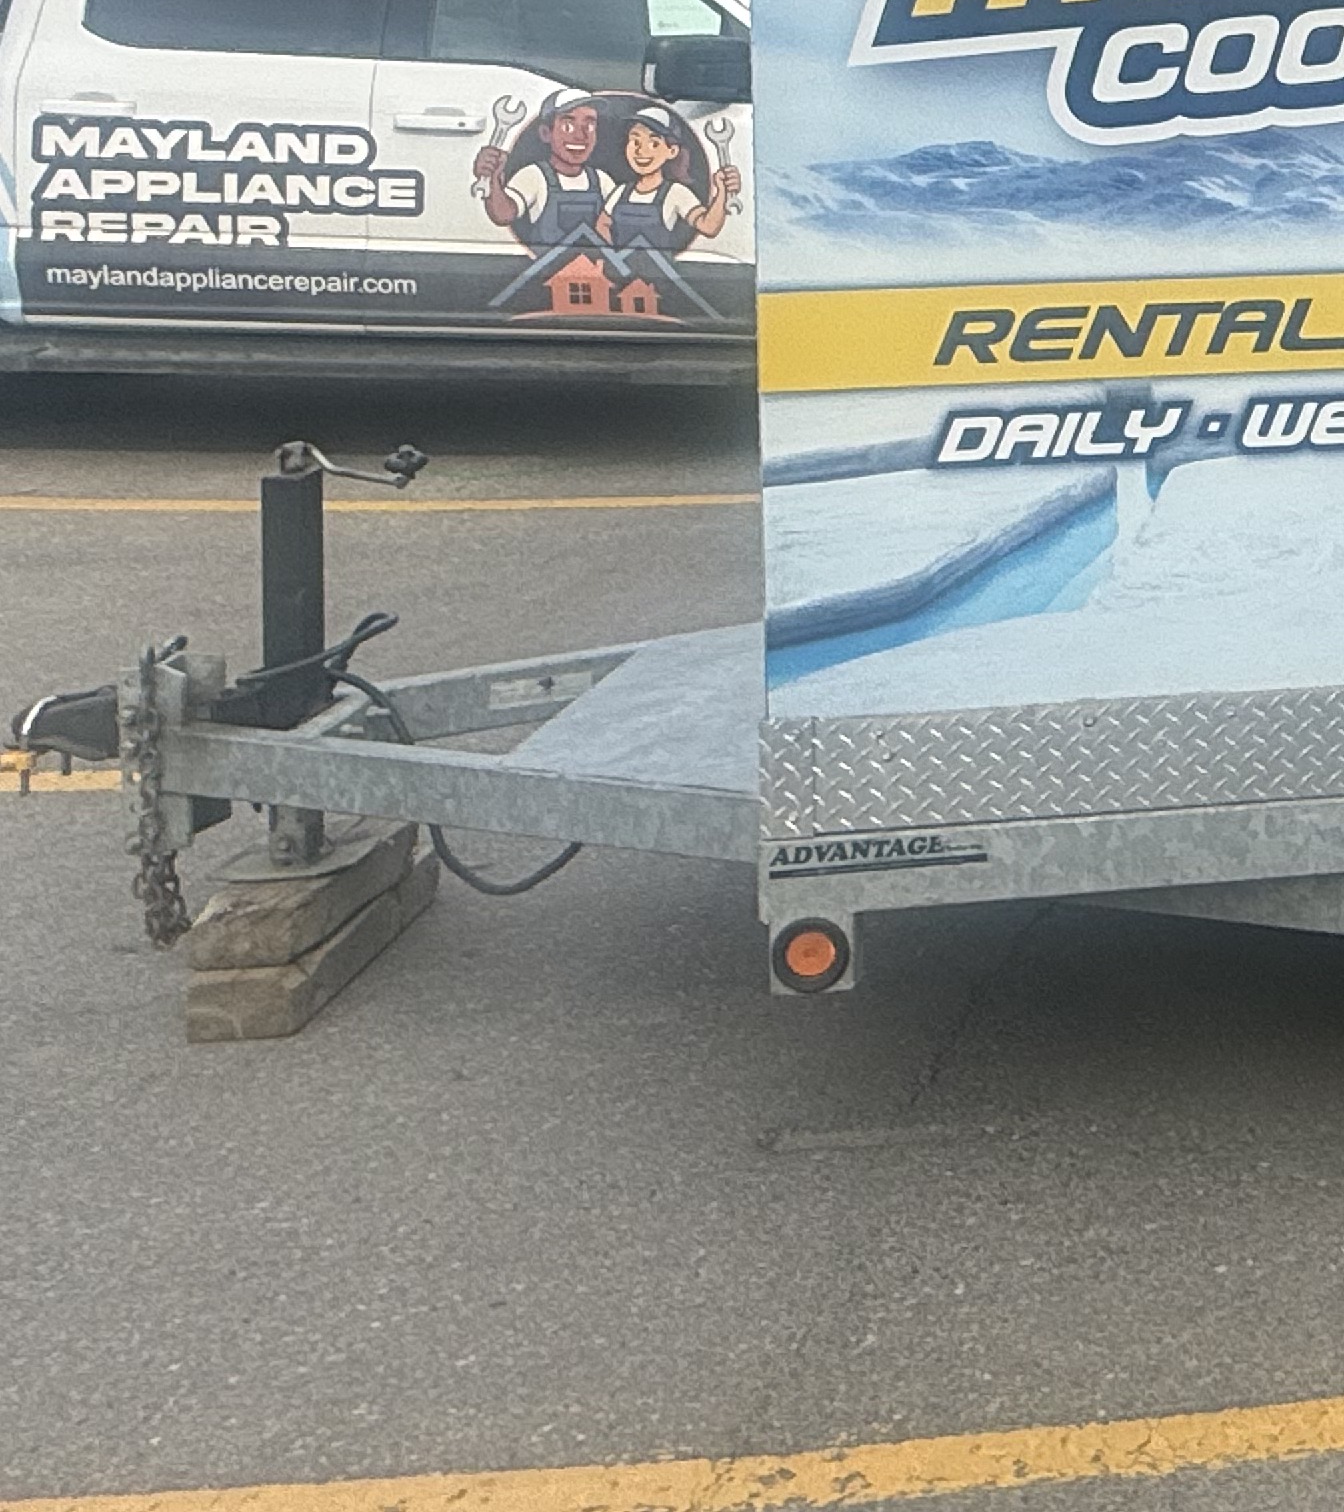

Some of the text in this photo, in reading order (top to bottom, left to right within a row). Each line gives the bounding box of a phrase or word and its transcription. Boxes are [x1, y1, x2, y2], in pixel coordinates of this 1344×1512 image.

[40, 124, 370, 165] MAYLAND
[41, 168, 417, 208] APPLIANCE
[40, 210, 282, 245] REPAIR
[46, 264, 417, 295] maylandappliancerepair.com
[936, 402, 1182, 466] DAILY
[769, 836, 945, 867] ADVANTAGE
